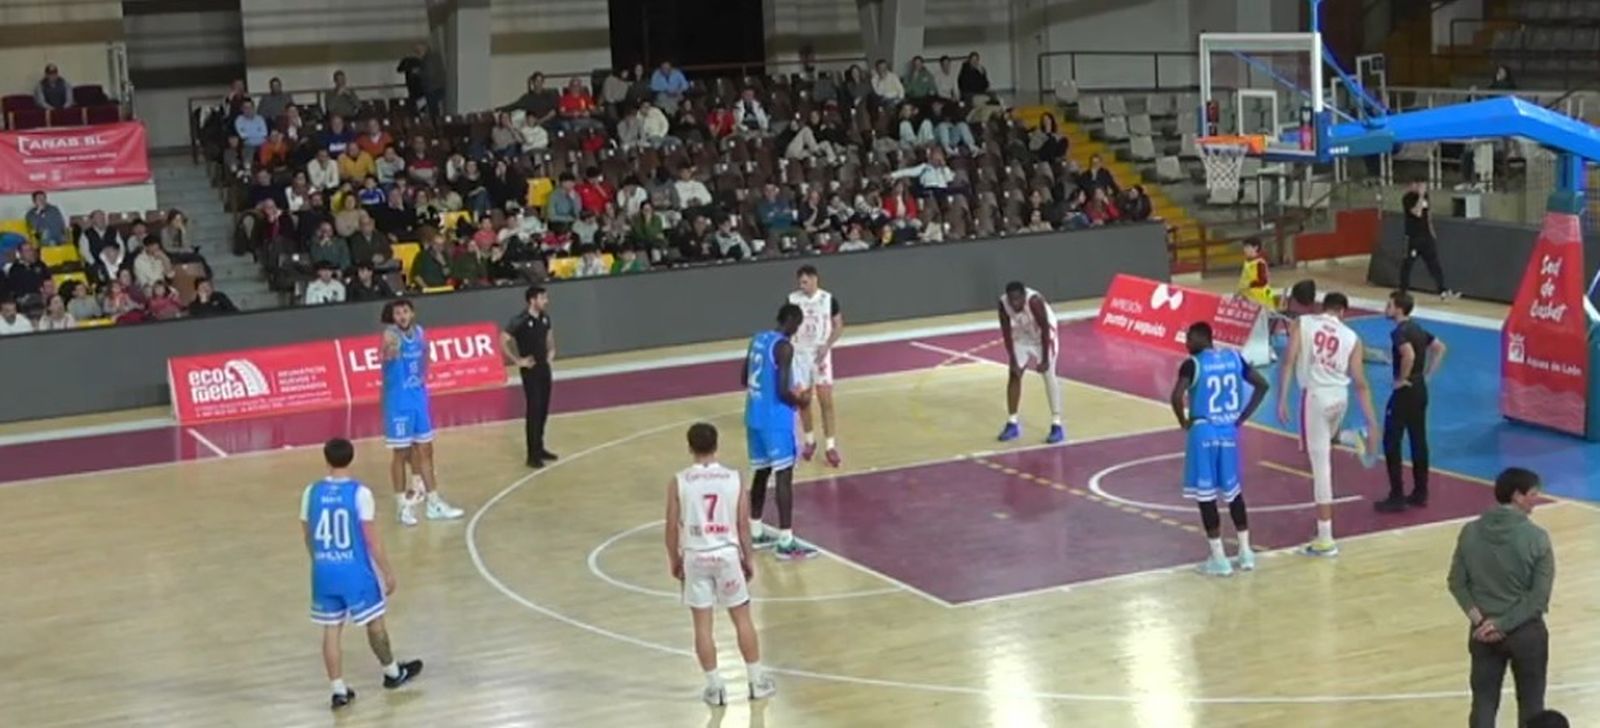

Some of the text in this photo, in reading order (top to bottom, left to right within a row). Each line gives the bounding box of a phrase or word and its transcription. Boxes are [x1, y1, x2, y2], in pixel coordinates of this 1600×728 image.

[1541, 254, 1563, 277] Sed
[1541, 278, 1556, 298] de
[1103, 313, 1128, 328] punto
[1126, 319, 1135, 332] y
[1135, 320, 1167, 337] seguido
[349, 334, 495, 372] LETUR
[1314, 331, 1339, 358] 99
[189, 369, 223, 386] eco
[192, 380, 245, 403] rueda
[1207, 374, 1238, 413] 23
[703, 494, 718, 522] 7
[314, 508, 350, 549] 40
